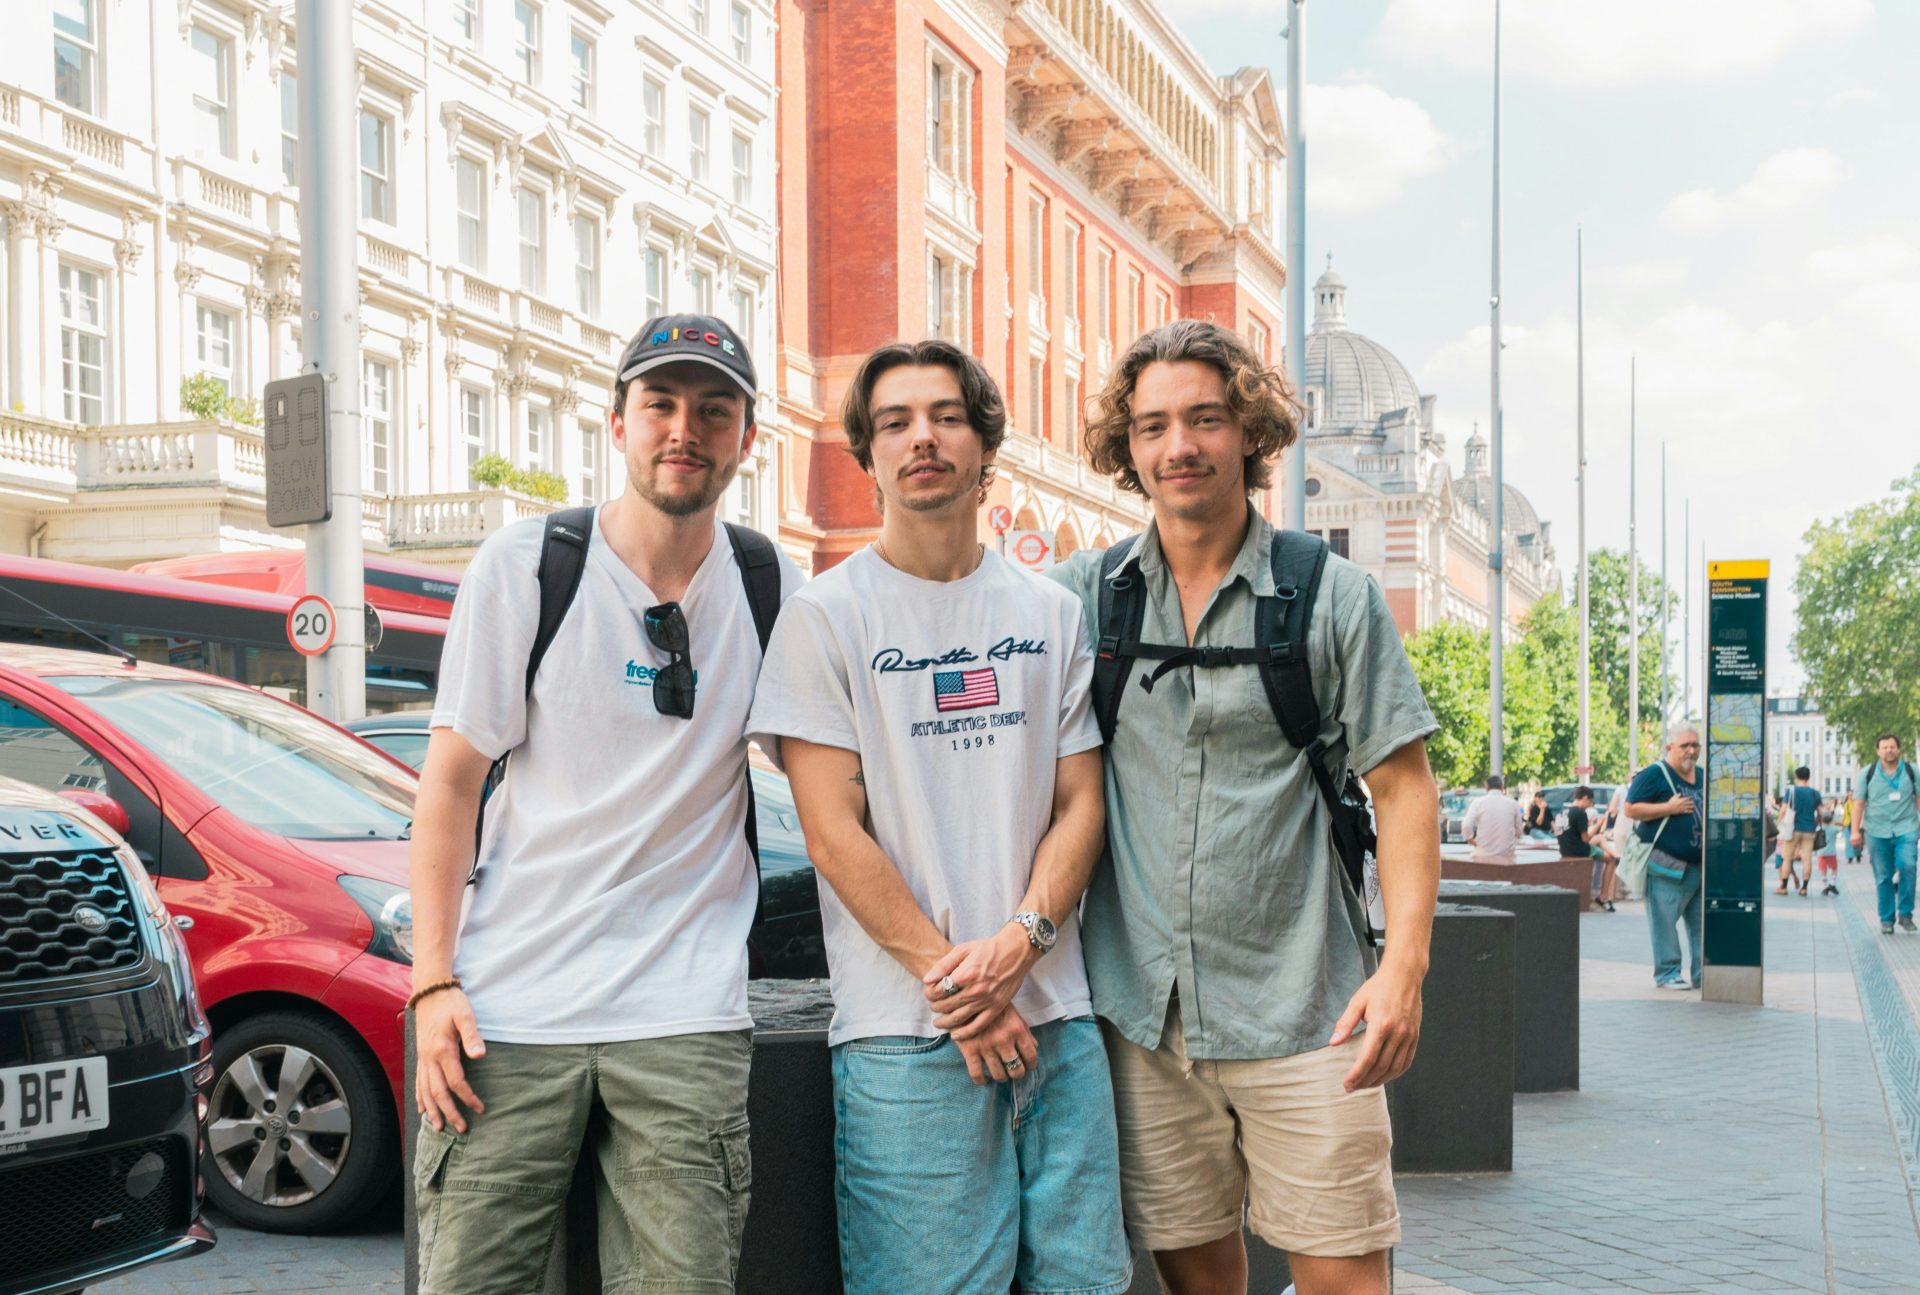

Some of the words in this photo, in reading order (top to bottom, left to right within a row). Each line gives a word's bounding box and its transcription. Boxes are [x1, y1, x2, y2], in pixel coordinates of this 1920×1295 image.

[652, 327, 735, 356] NICCE
[272, 456, 318, 486] SLOW
[272, 485, 320, 514] DOWN
[991, 508, 1007, 529] K
[295, 613, 327, 636] 20
[911, 715, 987, 737] ATHLETIC
[952, 734, 995, 751] 1998
